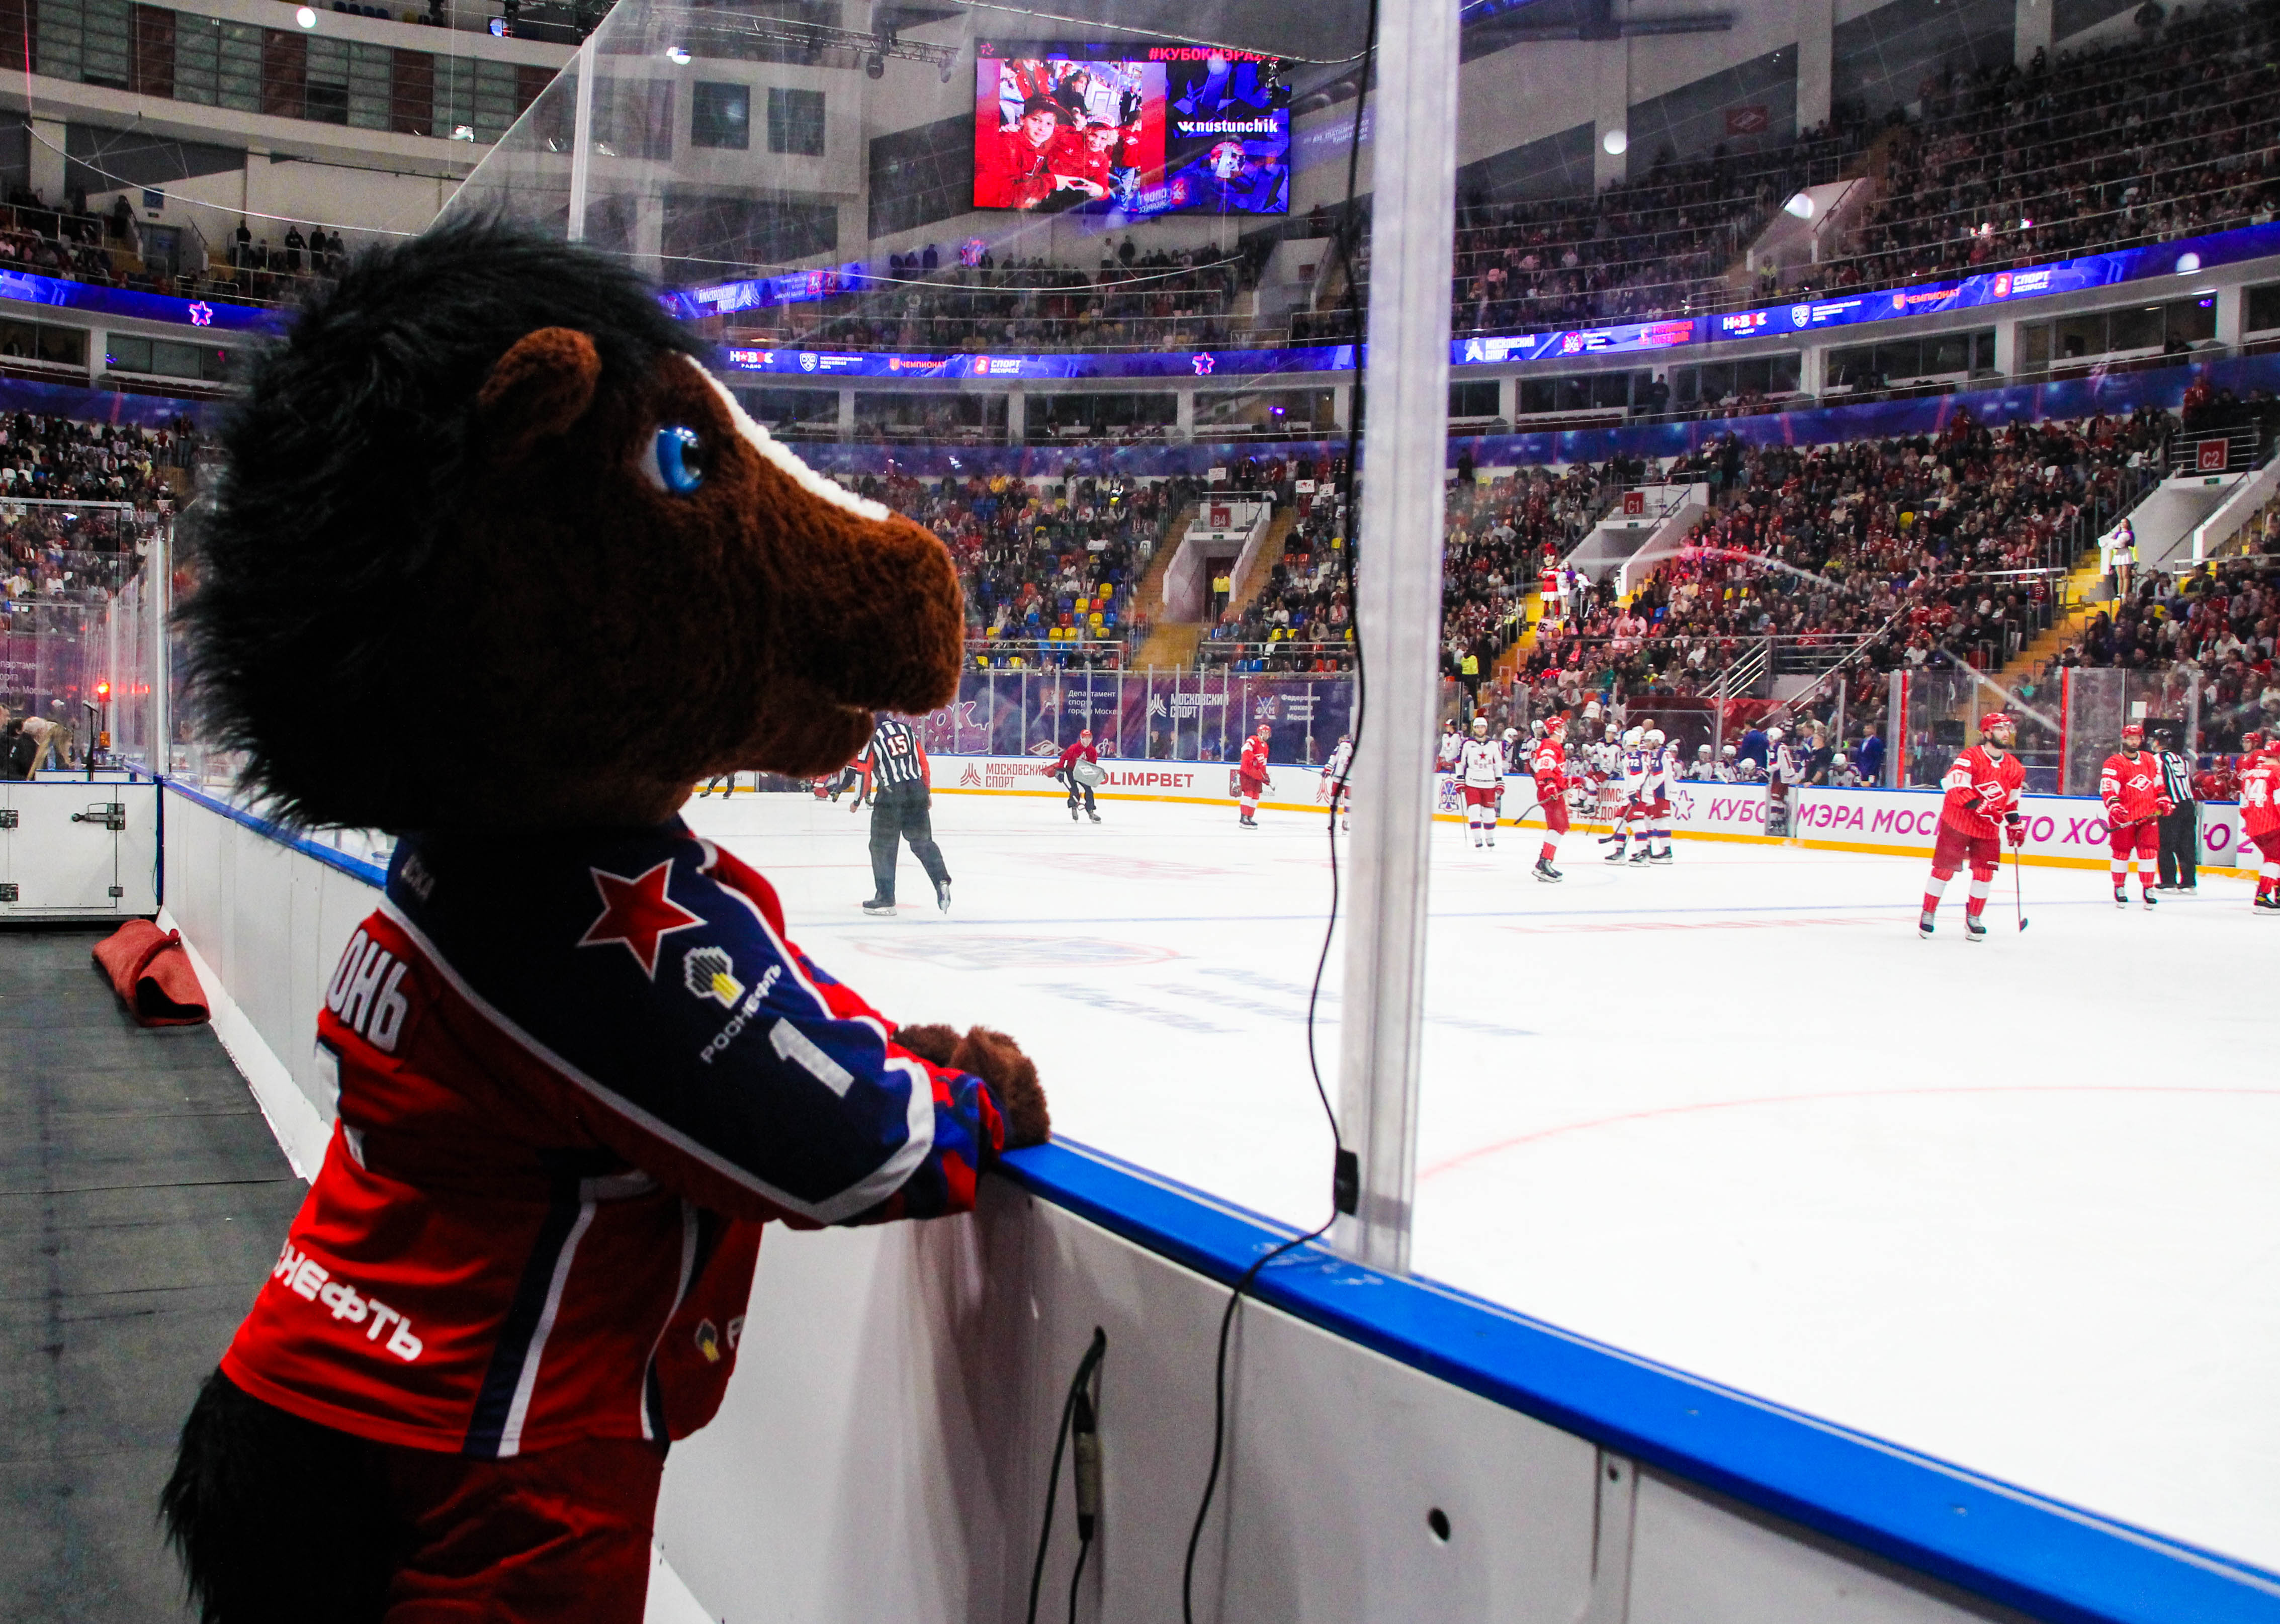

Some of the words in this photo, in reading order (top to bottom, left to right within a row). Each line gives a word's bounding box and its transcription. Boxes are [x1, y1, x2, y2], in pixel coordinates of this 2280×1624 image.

[1196, 119, 1278, 133] nustunchik
[2013, 270, 2051, 286] СПОРТ
[2012, 282, 2048, 294] ЭКСПРЕСС
[1906, 288, 1960, 304] ЧЕМПИОНАТ
[1485, 334, 1535, 349] МОСКОВСКИЙ
[1485, 348, 1509, 360] СПОРТ
[1170, 706, 1197, 718] СПОРТ
[887, 735, 908, 756] 15
[986, 776, 1014, 788] СПОРТ
[1953, 772, 1963, 784] 17
[1708, 798, 1766, 823] КУБО
[1796, 803, 1864, 830] МЭРА
[1871, 809, 1940, 836] МОС
[700, 964, 781, 1064] РОСНЕФТЬ
[768, 1016, 855, 1099] 1
[273, 1237, 423, 1362] НЕФТЬ
